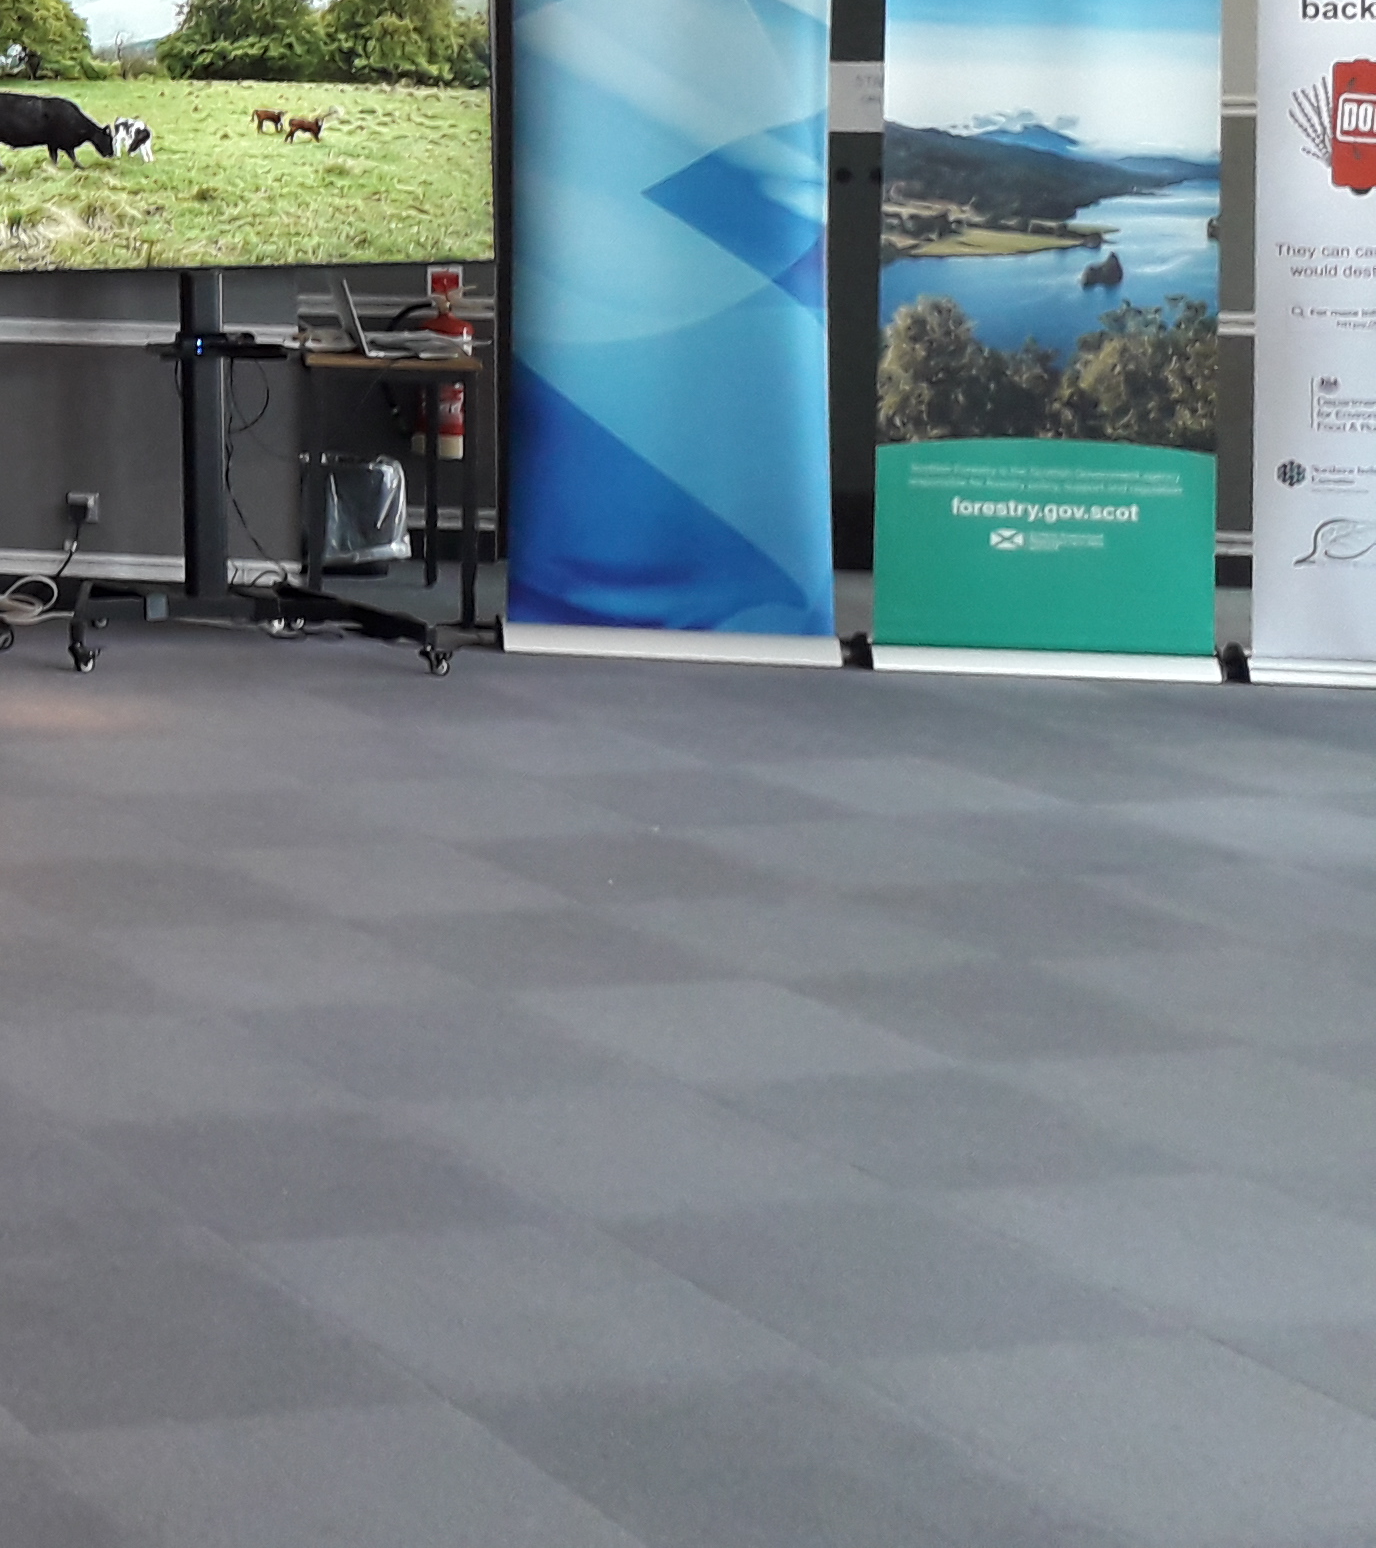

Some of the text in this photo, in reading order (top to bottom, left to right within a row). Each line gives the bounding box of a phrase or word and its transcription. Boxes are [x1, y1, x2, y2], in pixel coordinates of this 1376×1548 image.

[1342, 101, 1376, 133] DO
[1275, 242, 1316, 259] They
[1321, 246, 1350, 257] can
[1290, 264, 1337, 277] would
[951, 496, 1140, 524] forestry.gov.scot
